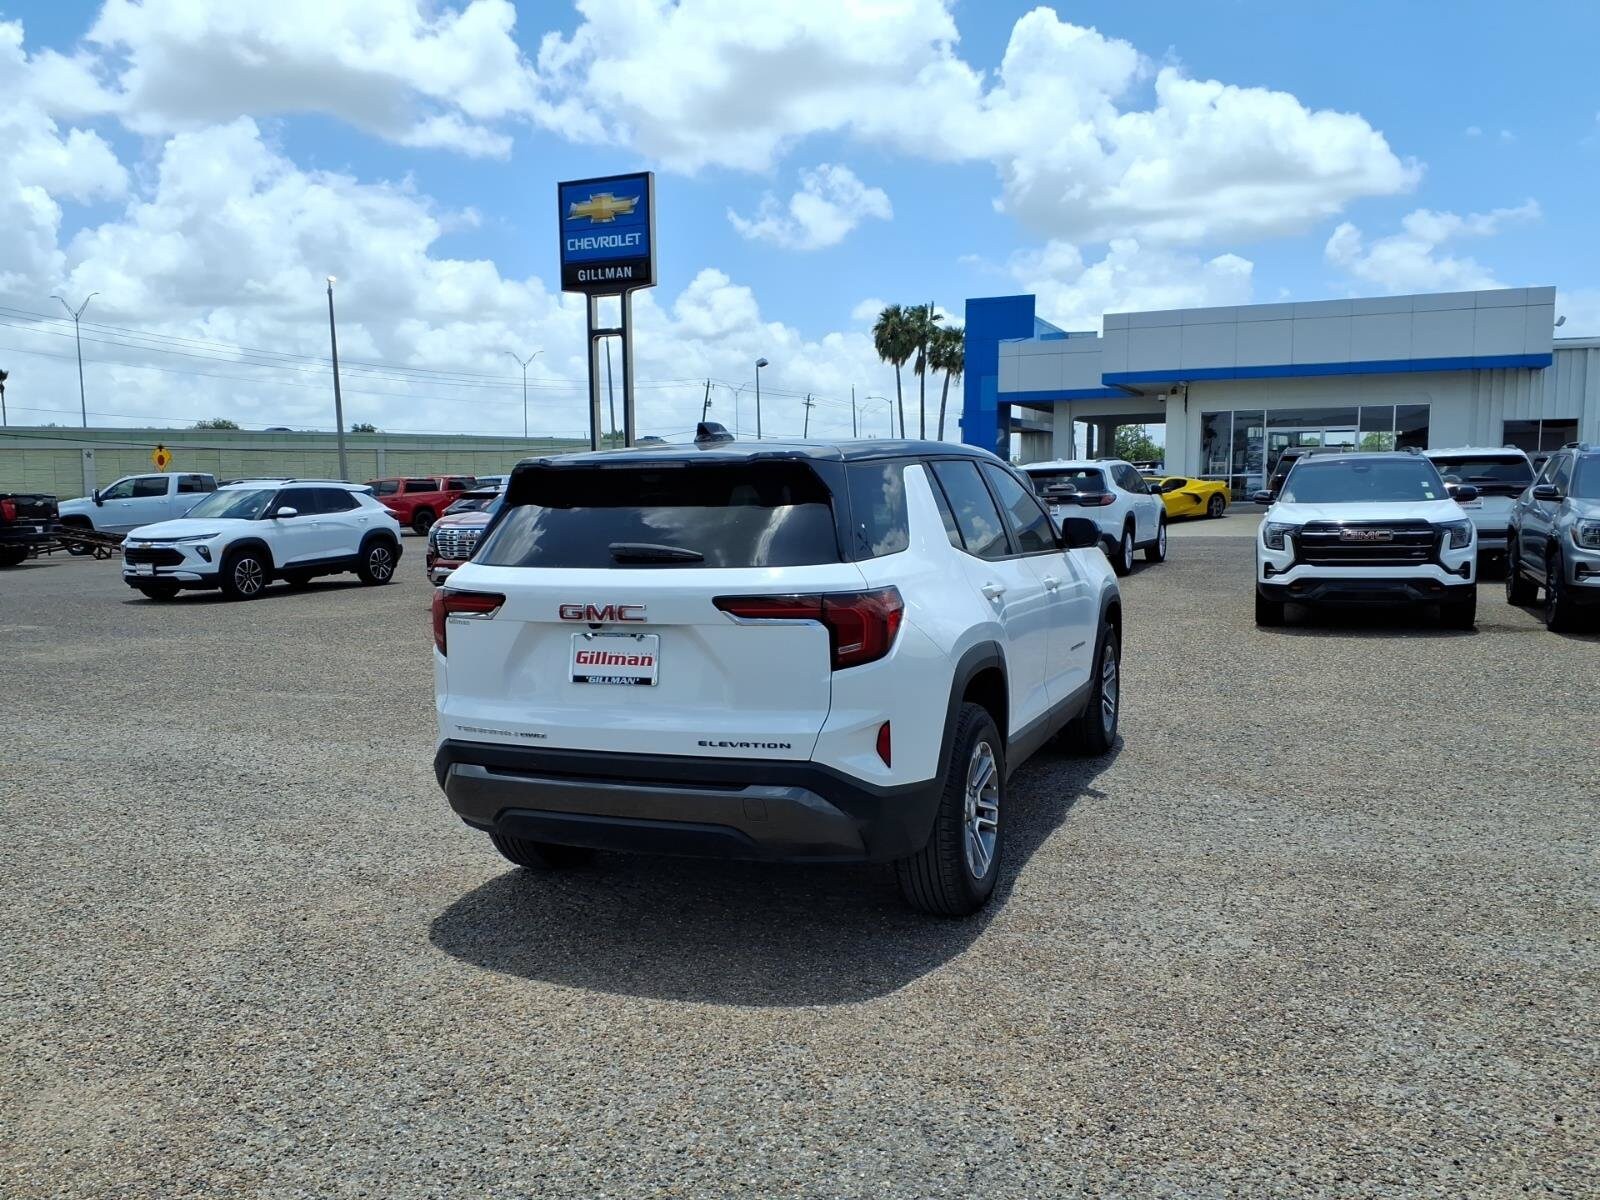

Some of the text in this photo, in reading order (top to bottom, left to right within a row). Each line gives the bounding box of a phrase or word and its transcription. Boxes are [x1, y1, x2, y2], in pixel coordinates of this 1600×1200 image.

[567, 232, 642, 251] CHEVROLET
[578, 266, 632, 281] GILLMAN
[1342, 528, 1391, 540] GMC
[558, 603, 647, 622] GMC
[575, 650, 653, 667] Gillman
[697, 740, 792, 749] ELEVATION
